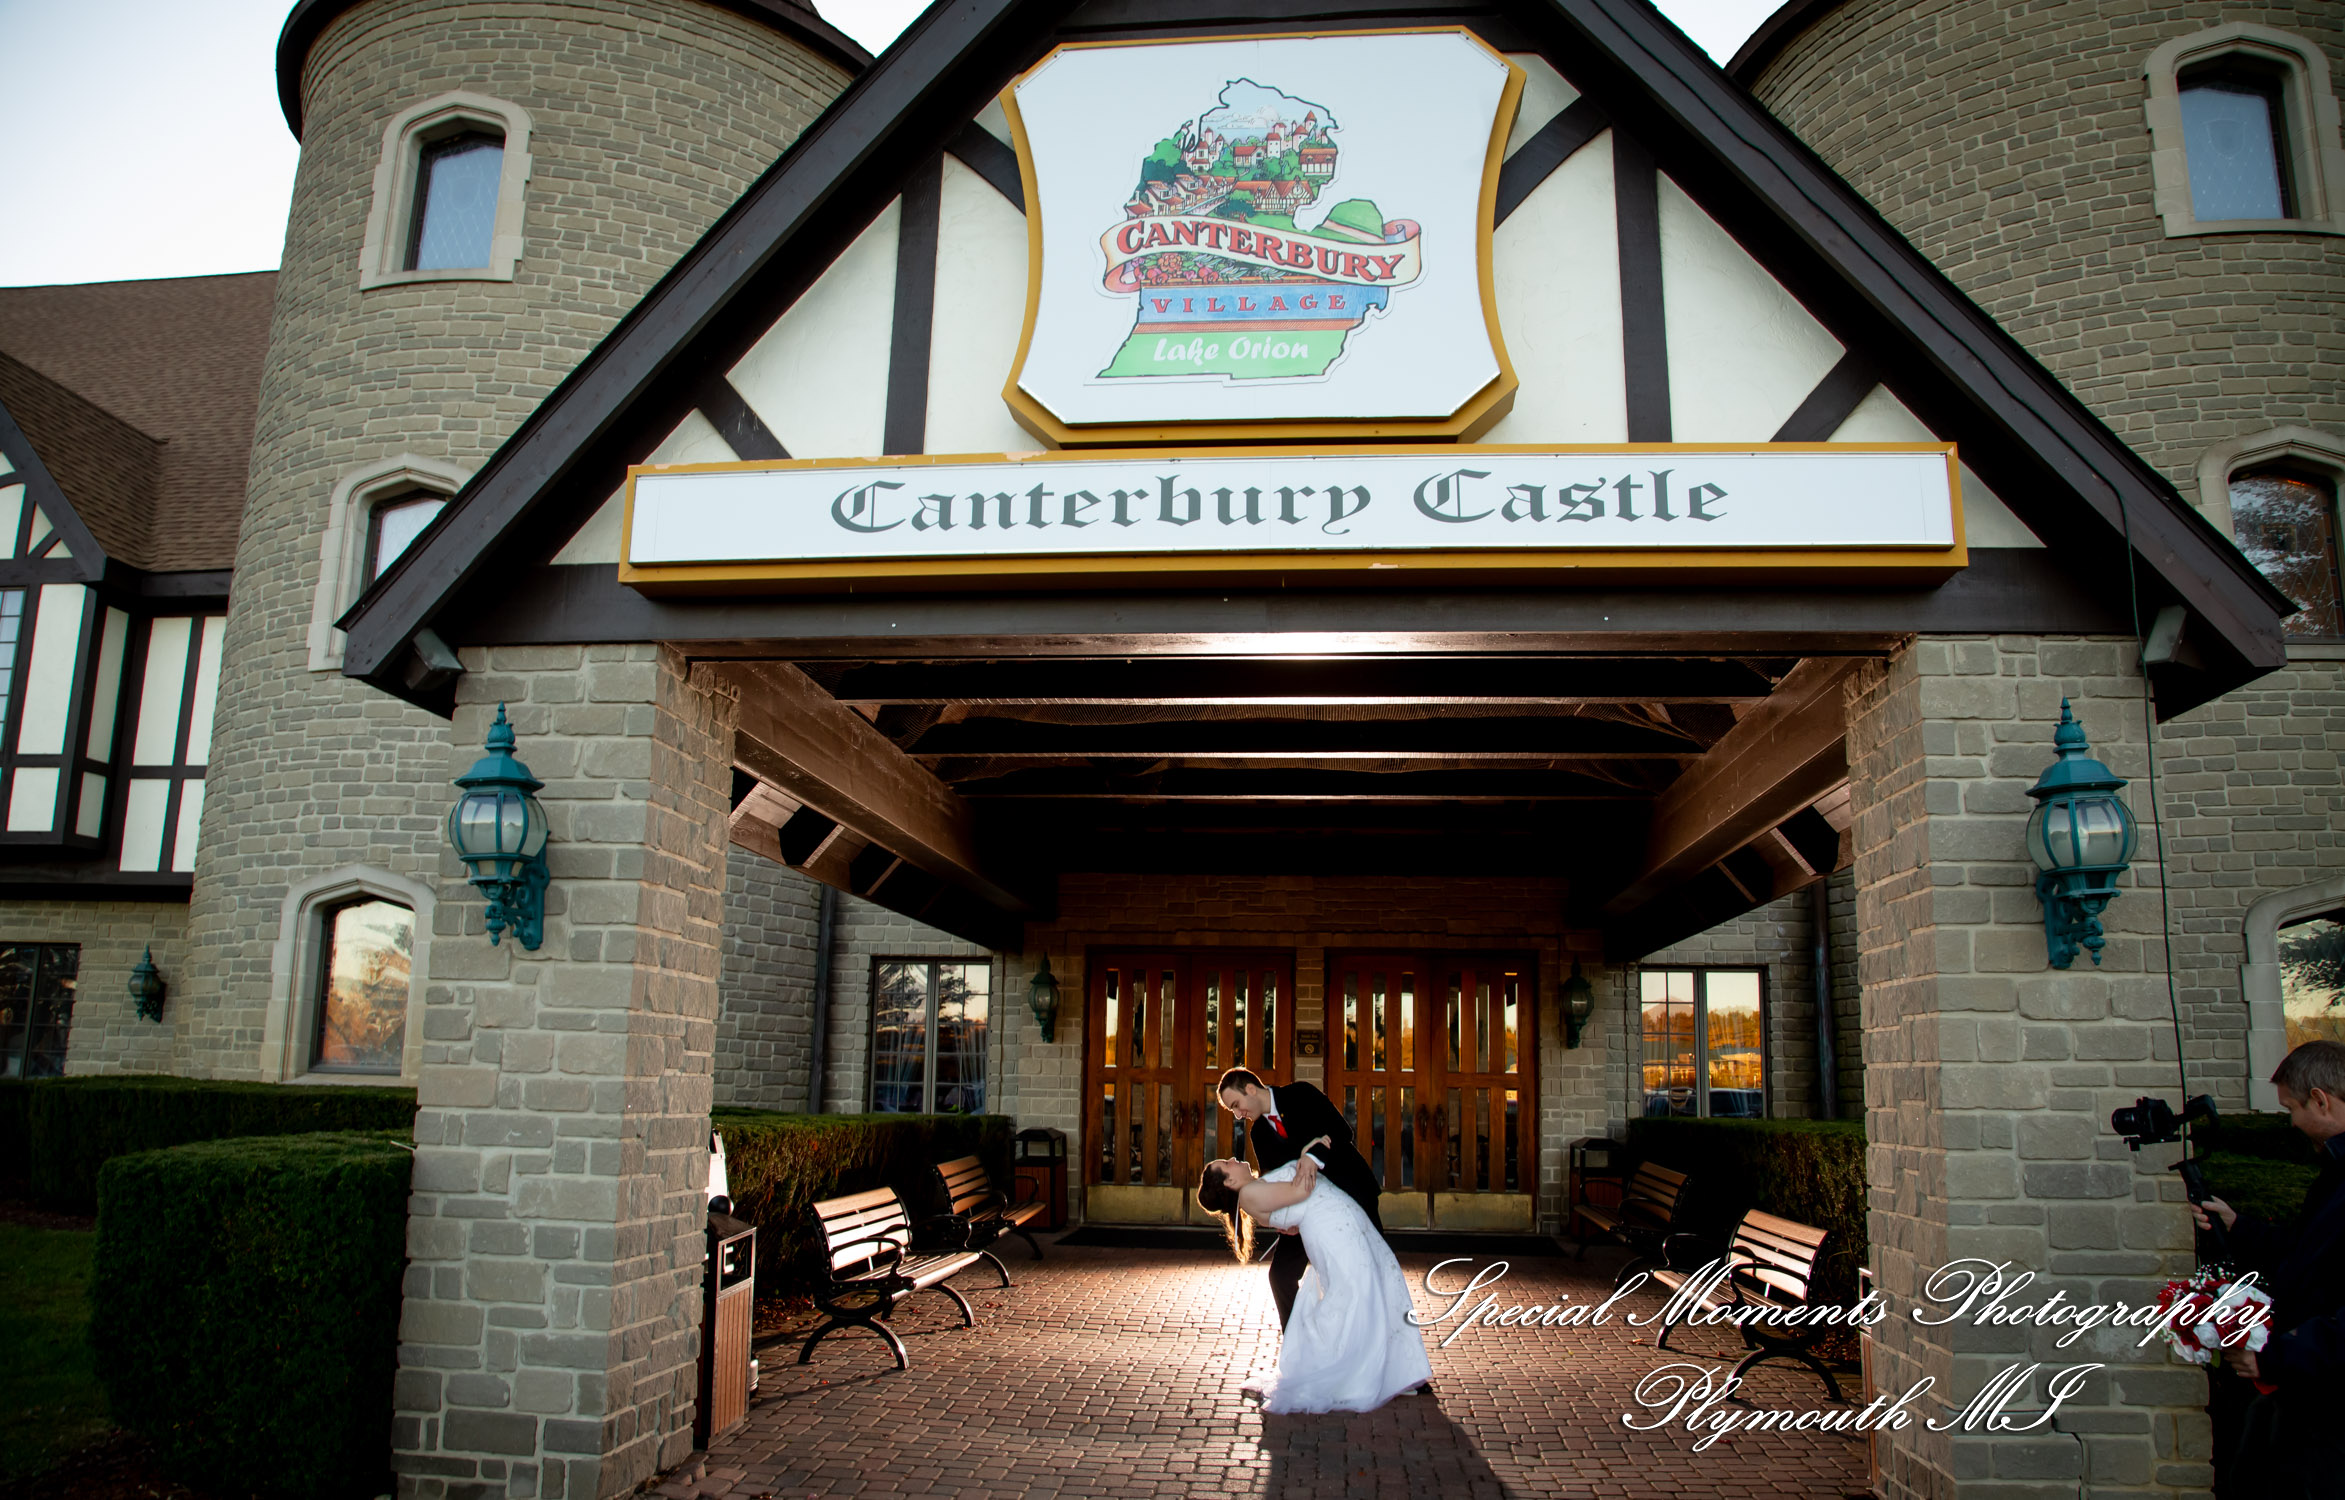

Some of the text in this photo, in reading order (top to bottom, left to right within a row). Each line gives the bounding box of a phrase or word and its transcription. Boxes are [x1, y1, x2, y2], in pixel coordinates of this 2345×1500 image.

[1116, 220, 1406, 280] CANTERBURY
[1150, 294, 1347, 314] VILLAGE
[1154, 336, 1309, 366] Lake Orion
[831, 468, 1728, 535] Canterbury Castle
